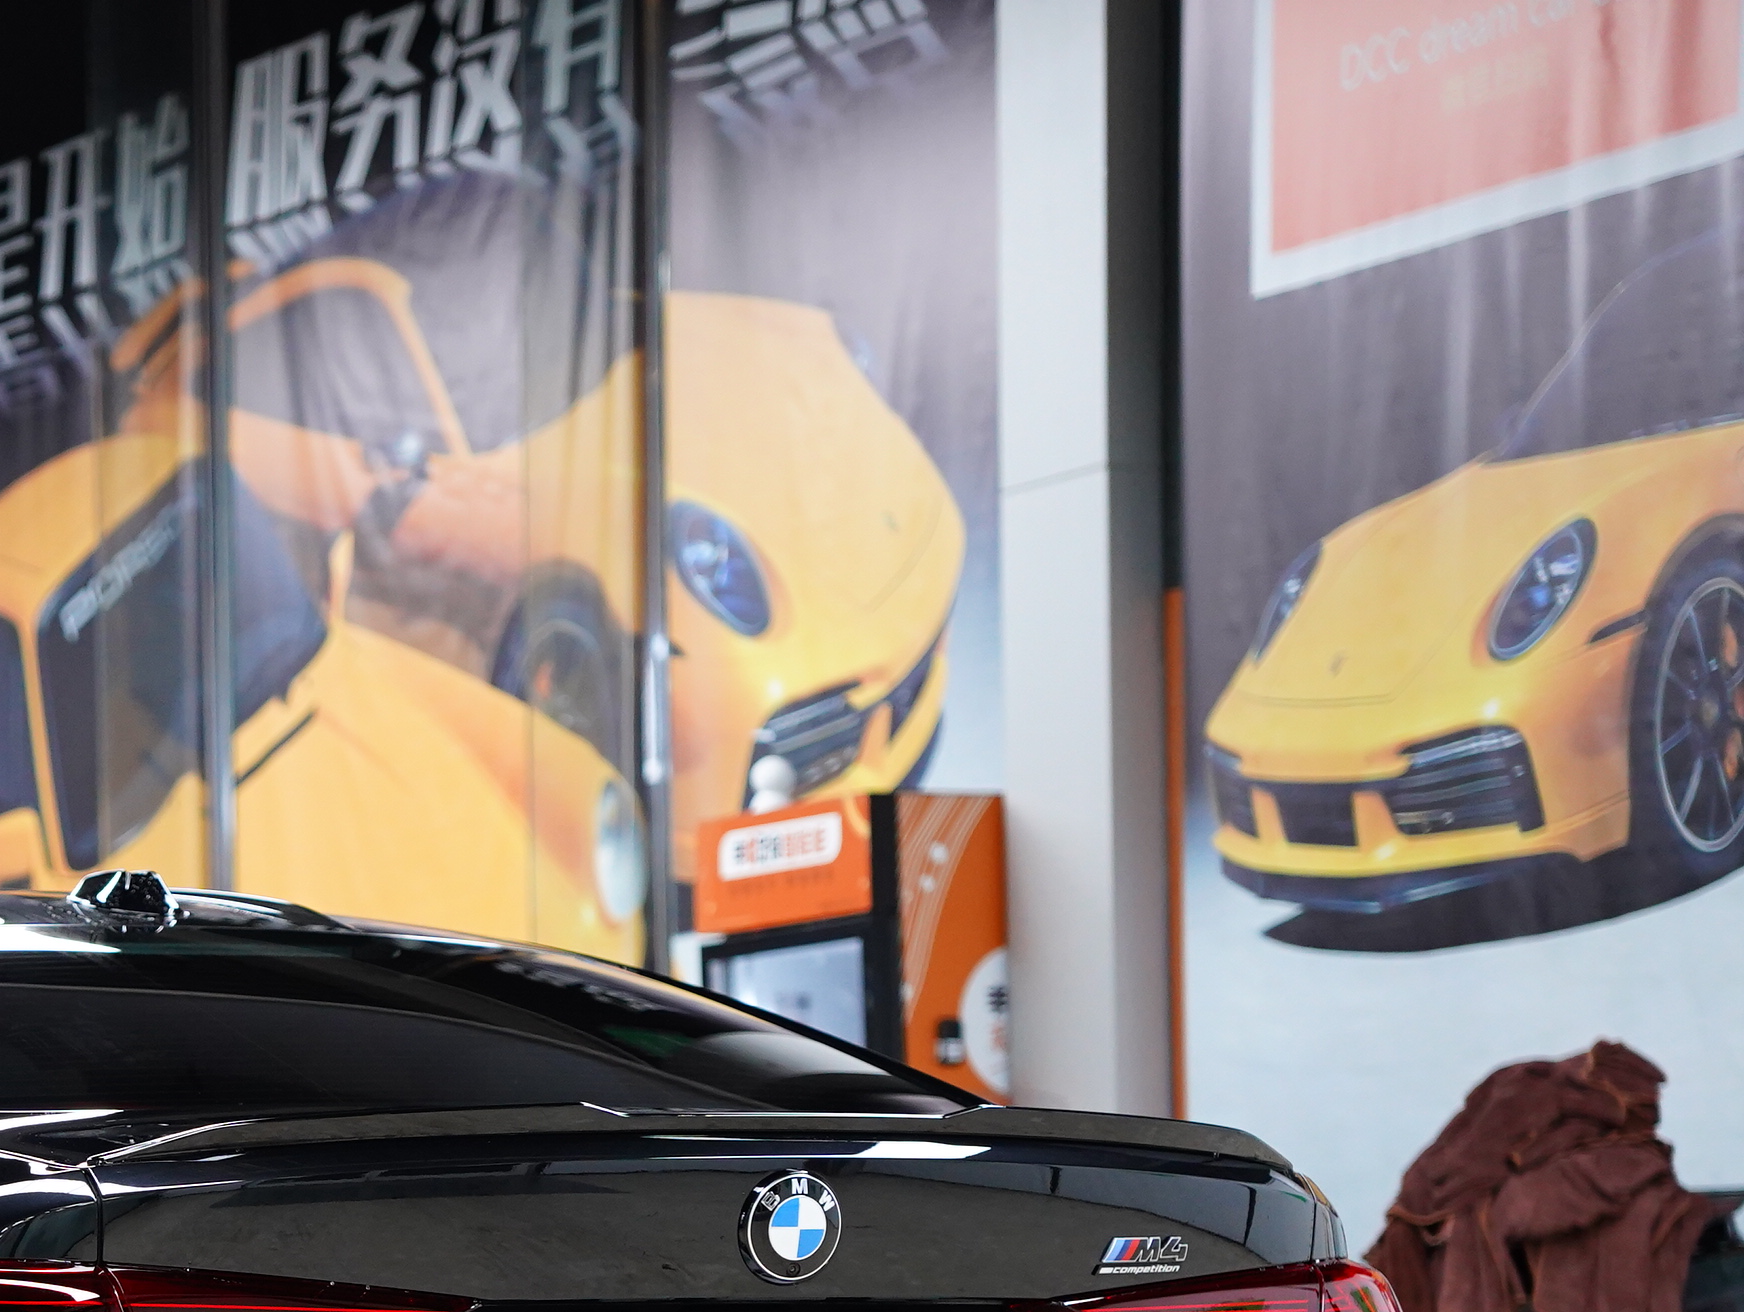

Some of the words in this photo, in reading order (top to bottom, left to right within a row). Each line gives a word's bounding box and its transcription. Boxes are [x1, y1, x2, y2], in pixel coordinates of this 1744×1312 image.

[1339, 26, 1411, 91] DCC
[761, 1178, 835, 1212] BMW
[1102, 1236, 1189, 1263] M4
[1112, 1264, 1181, 1275] competition
